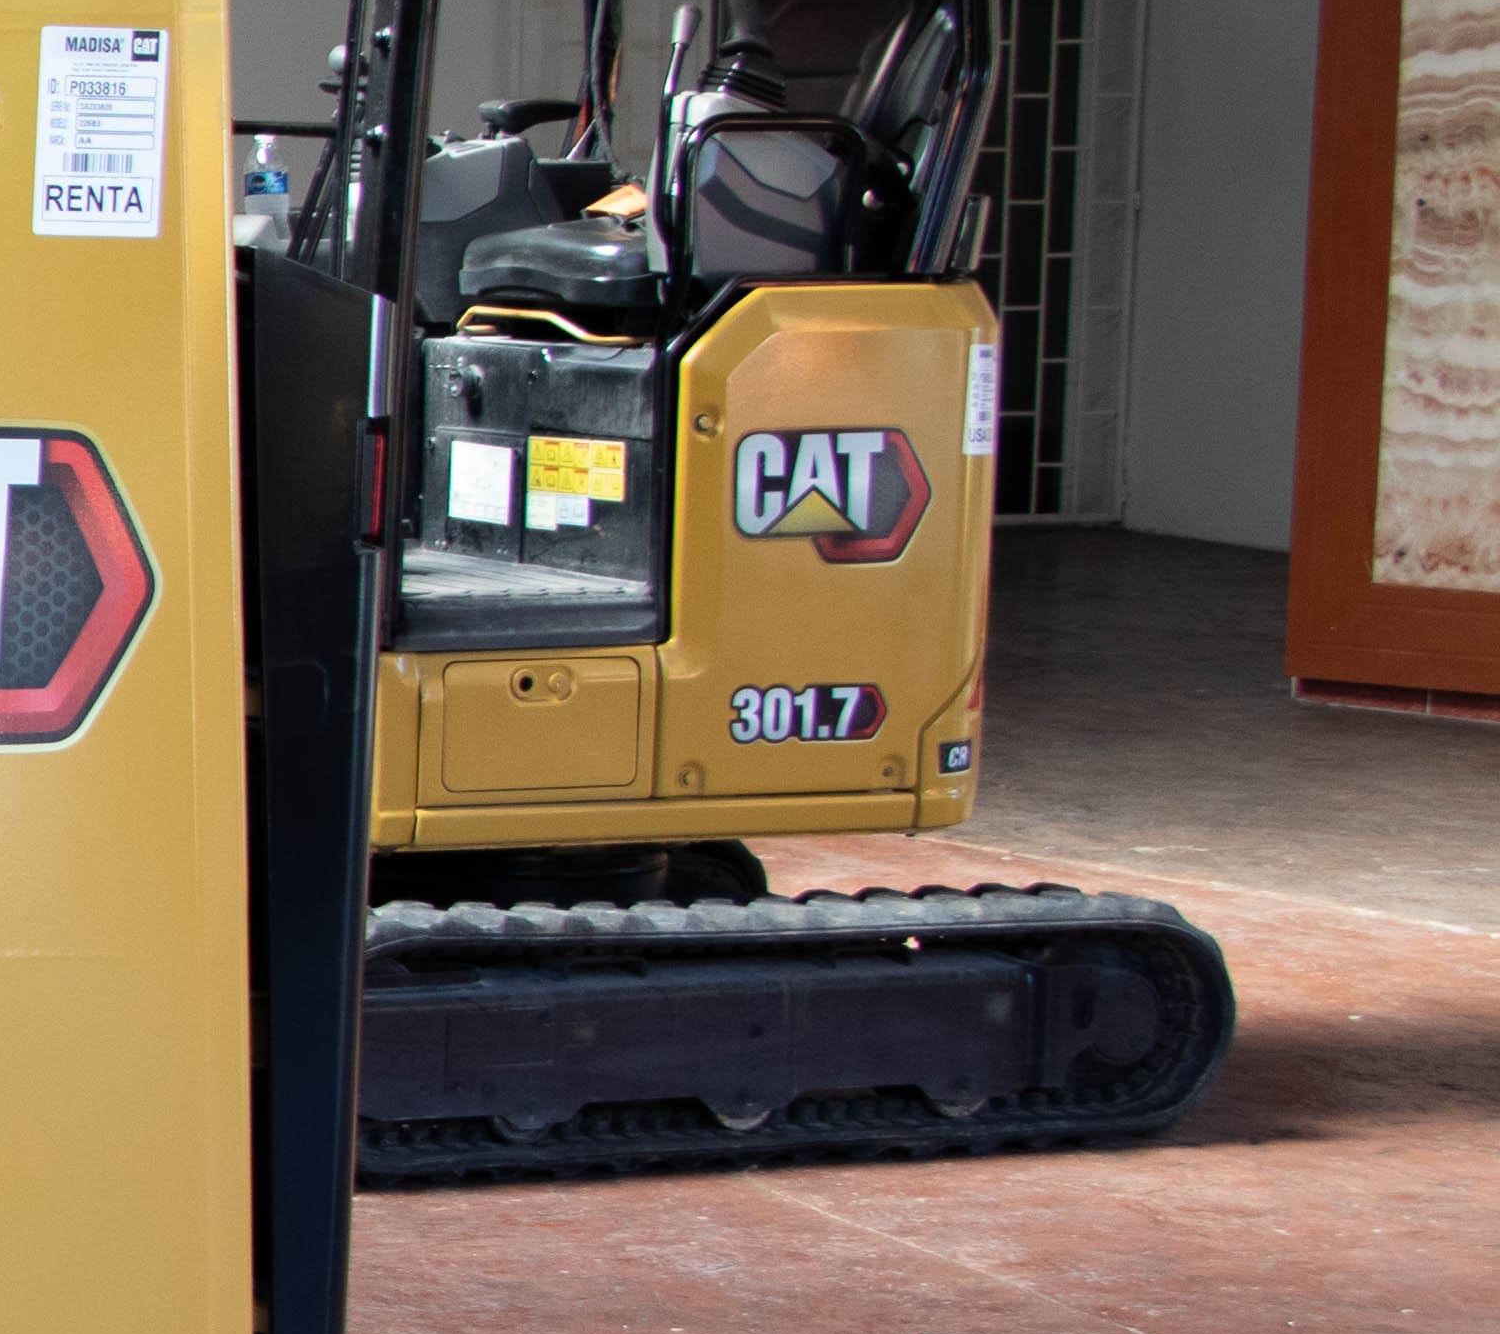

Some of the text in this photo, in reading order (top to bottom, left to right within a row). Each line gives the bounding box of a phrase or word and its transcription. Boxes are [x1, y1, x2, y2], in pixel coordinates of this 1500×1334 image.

[132, 37, 157, 56] CAT
[69, 80, 127, 96] P033816
[45, 183, 144, 214] RENTA
[736, 432, 885, 534] CAT
[730, 686, 862, 742] 301.7
[947, 745, 970, 769] CR
